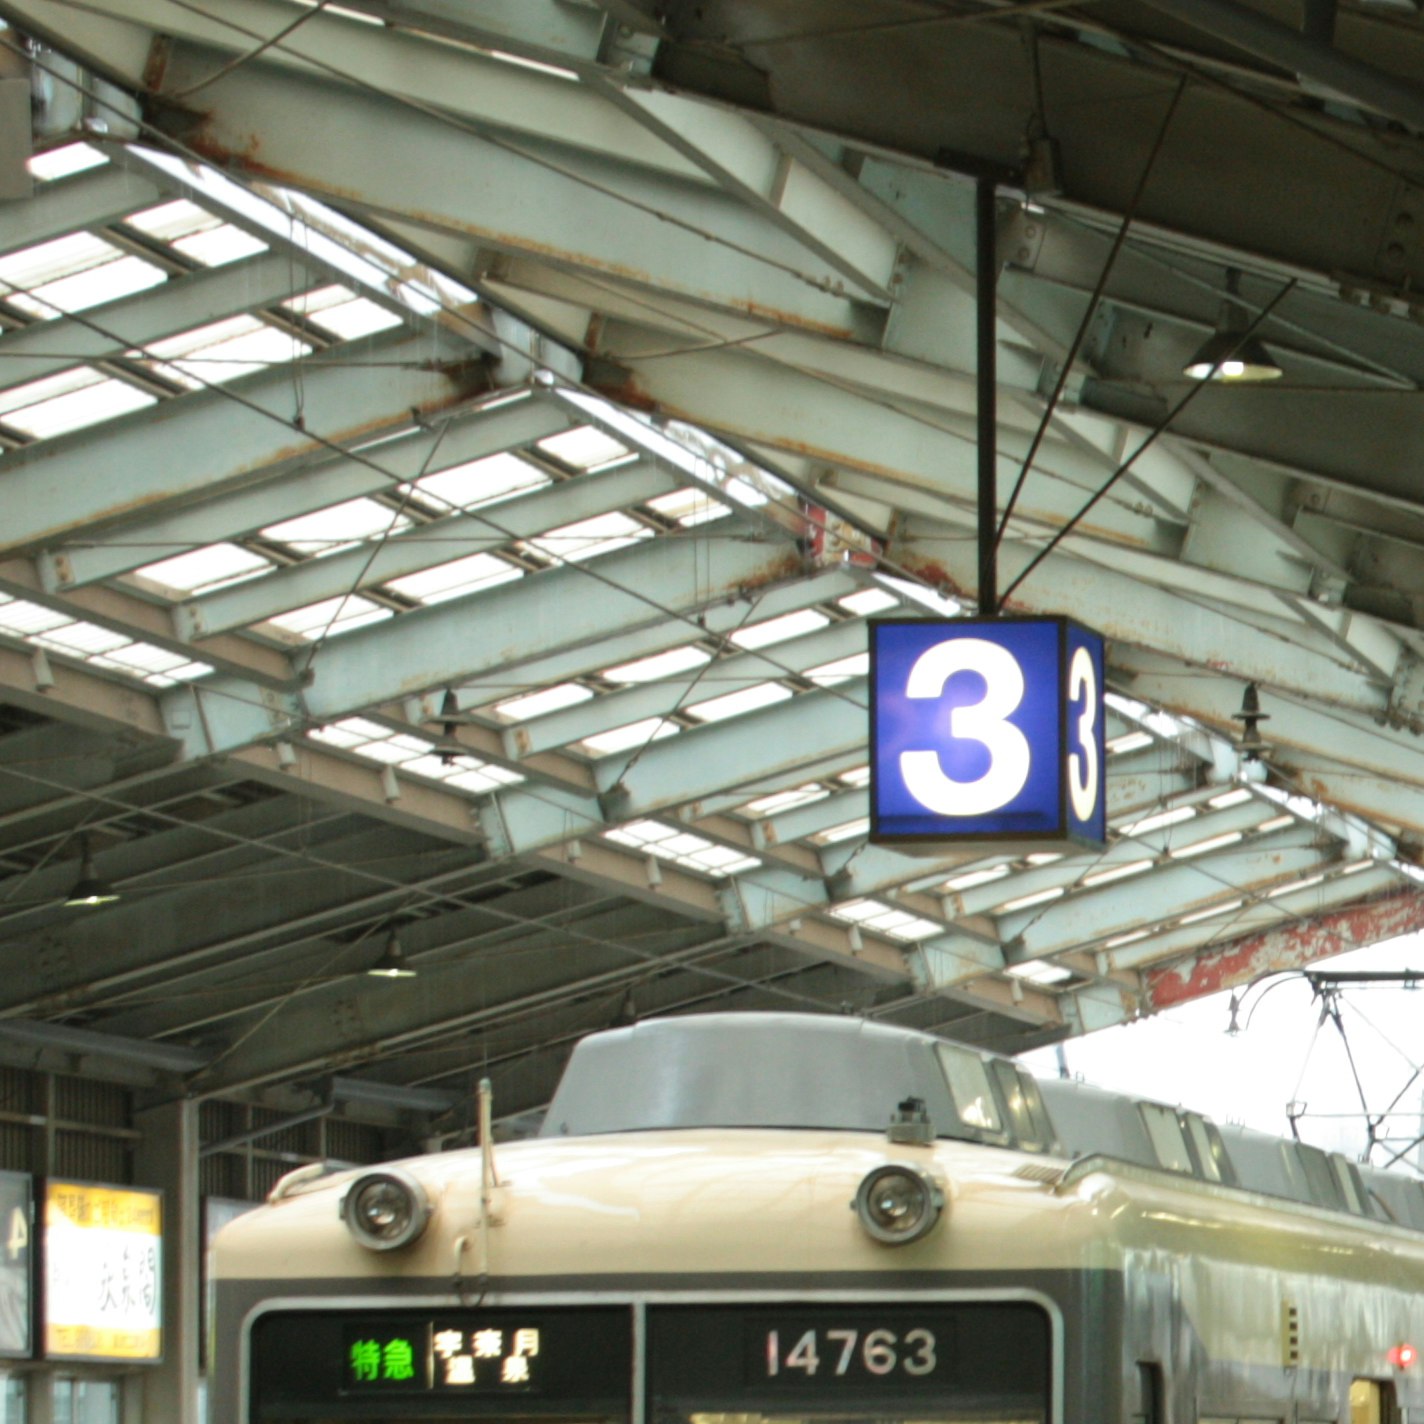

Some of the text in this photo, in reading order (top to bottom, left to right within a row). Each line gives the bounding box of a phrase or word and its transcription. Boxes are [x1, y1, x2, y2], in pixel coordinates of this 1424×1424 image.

[900, 638, 1030, 816] 3
[1068, 647, 1098, 821] 3
[351, 1339, 414, 1381] 特急
[767, 1328, 937, 1376] 14763
